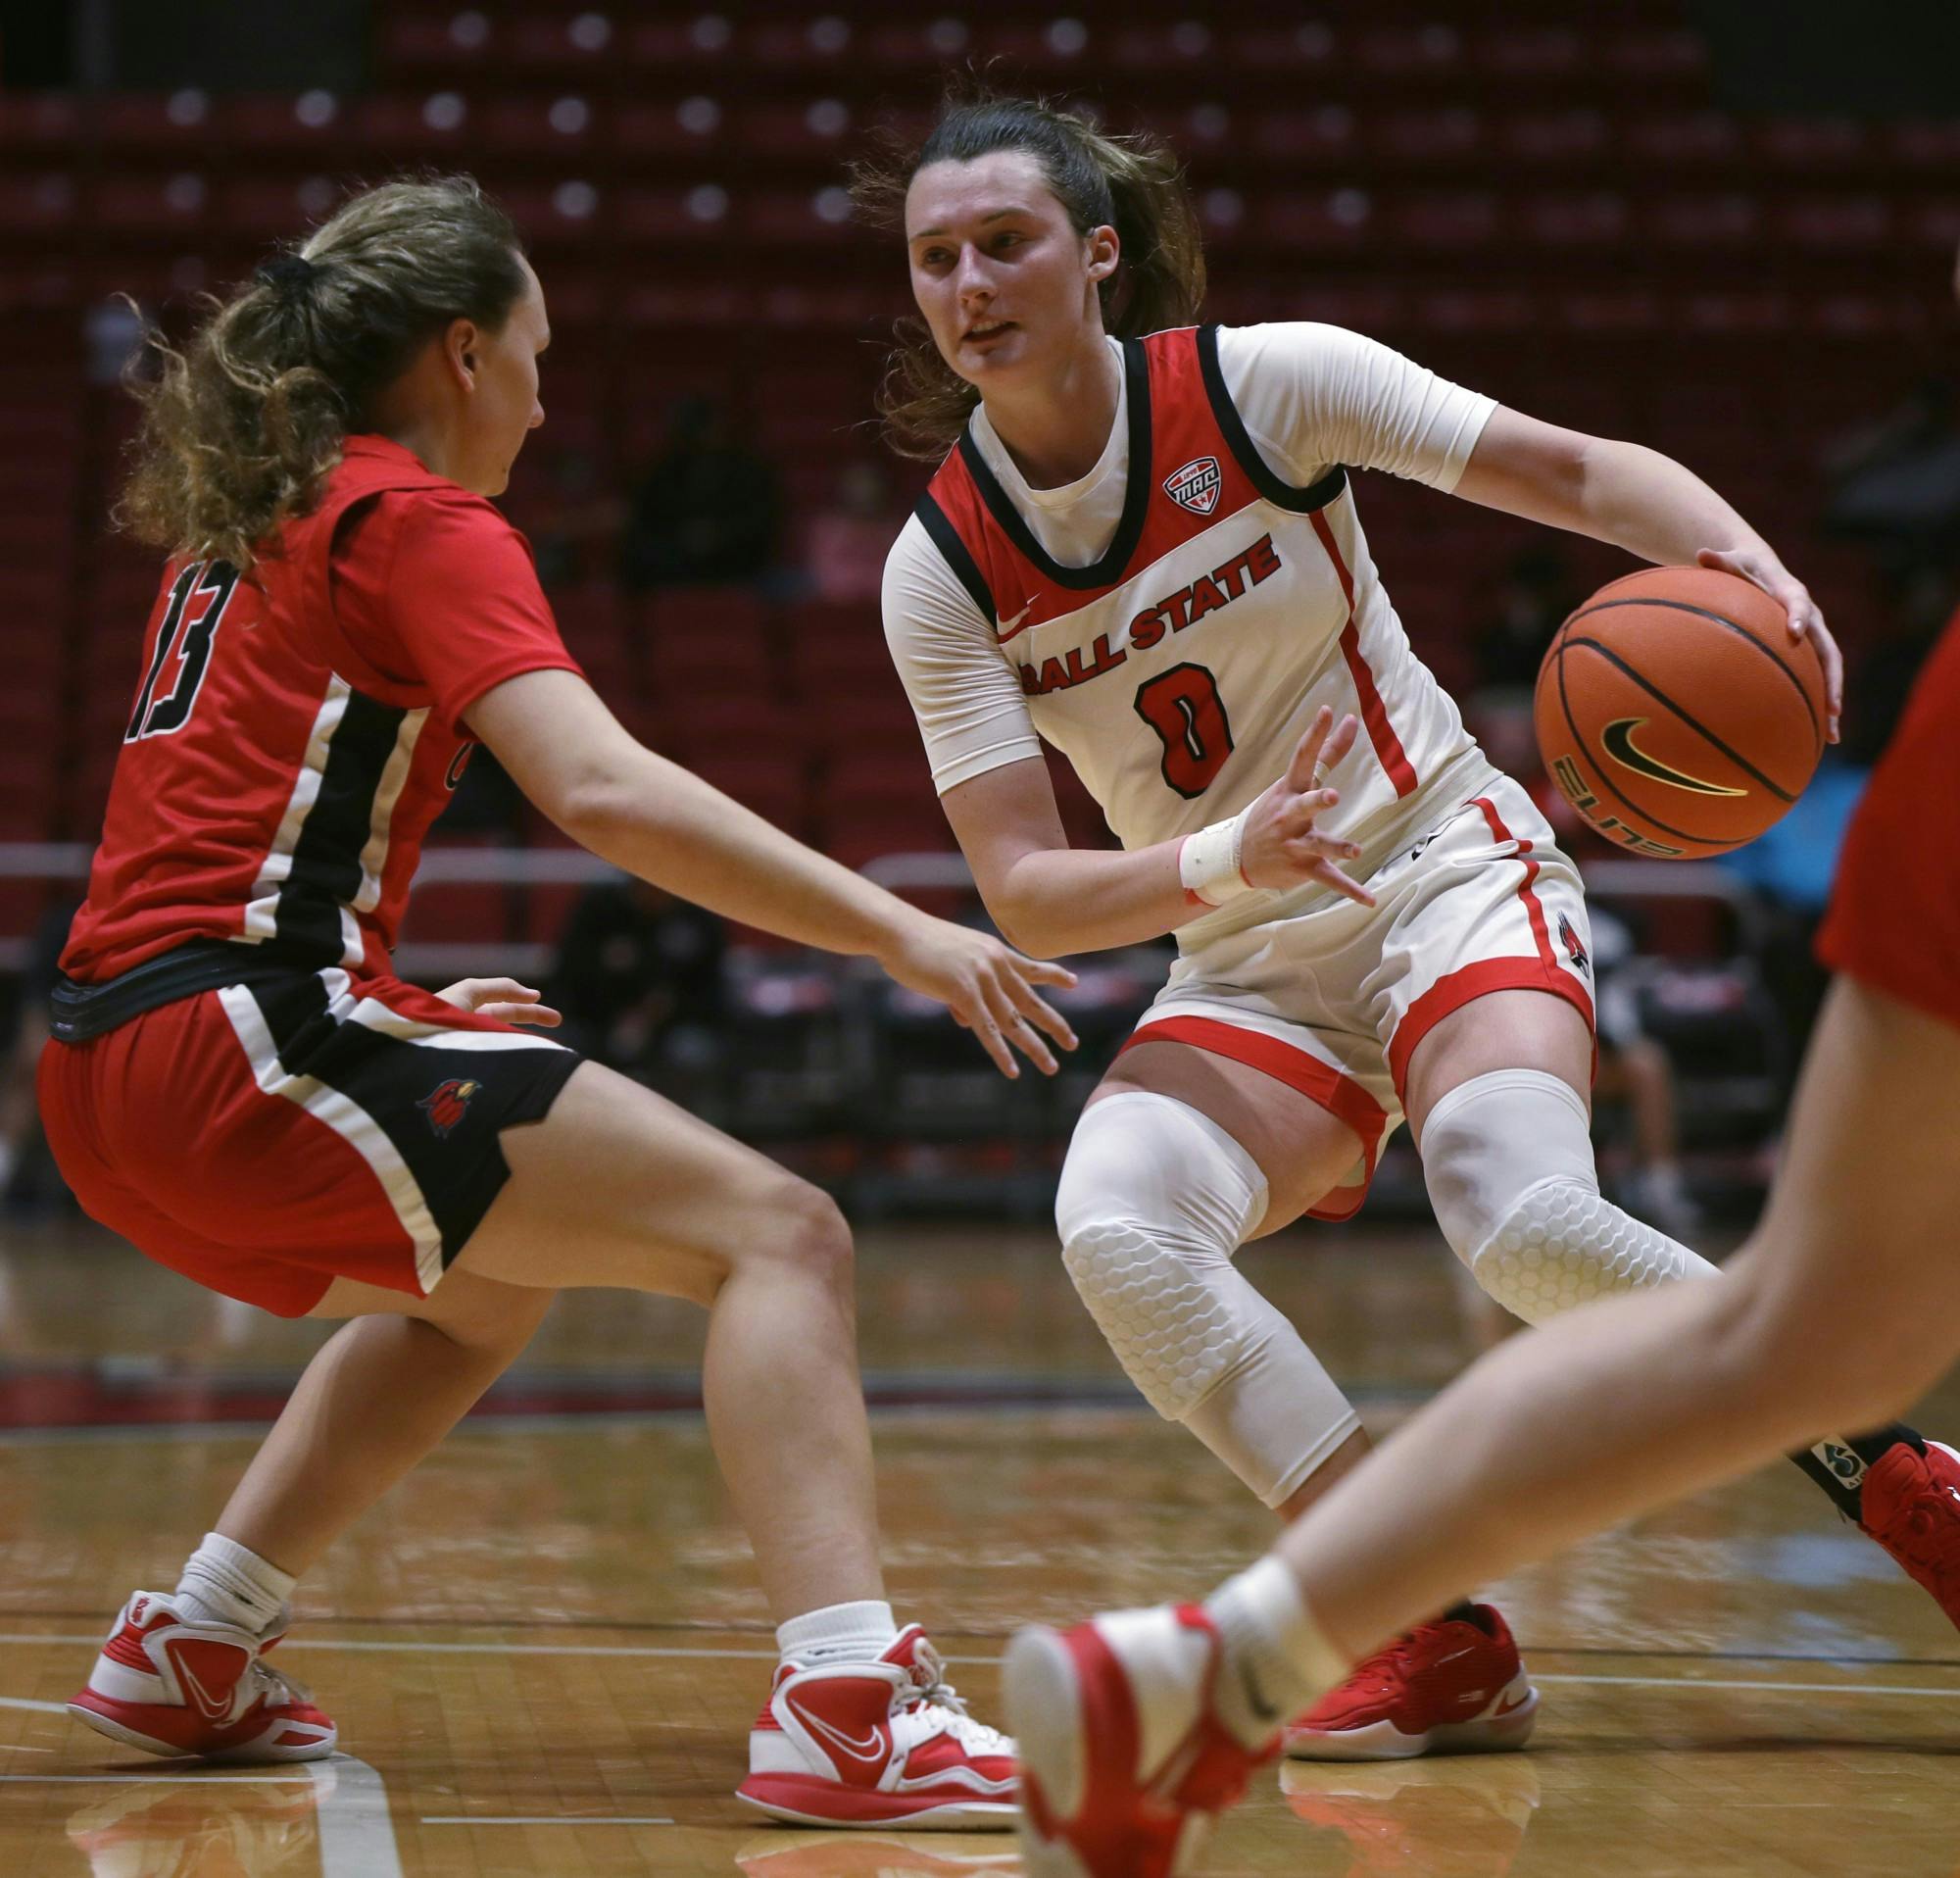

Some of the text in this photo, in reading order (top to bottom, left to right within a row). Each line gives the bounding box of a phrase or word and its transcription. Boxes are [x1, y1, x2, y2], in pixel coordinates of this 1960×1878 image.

[1173, 469, 1219, 503] MAC
[123, 559, 241, 744] 13
[1018, 532, 1281, 695] BALL STATE
[1134, 662, 1235, 800] 0
